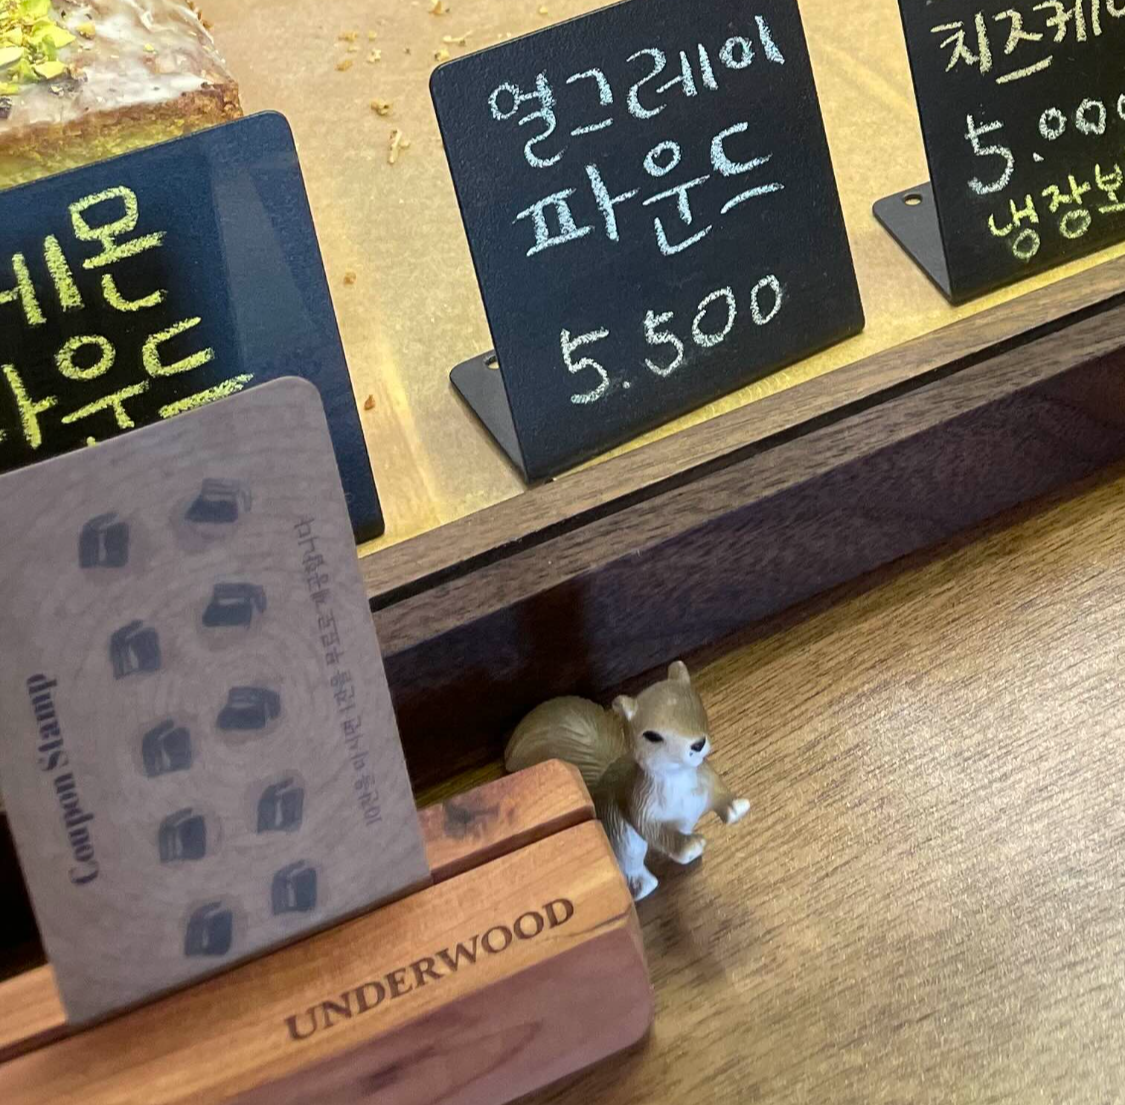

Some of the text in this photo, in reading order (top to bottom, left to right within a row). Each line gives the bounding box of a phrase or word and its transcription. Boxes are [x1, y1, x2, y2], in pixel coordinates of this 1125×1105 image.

[487, 14, 785, 168] 얼그레이
[511, 121, 785, 257] 파운드
[559, 273, 785, 405] 5.500
[315, 609, 346, 666] 무료로
[26, 673, 100, 886] Coupon Stamp
[339, 715, 371, 771] 마시면
[283, 897, 575, 1041] UNDERWOOD
